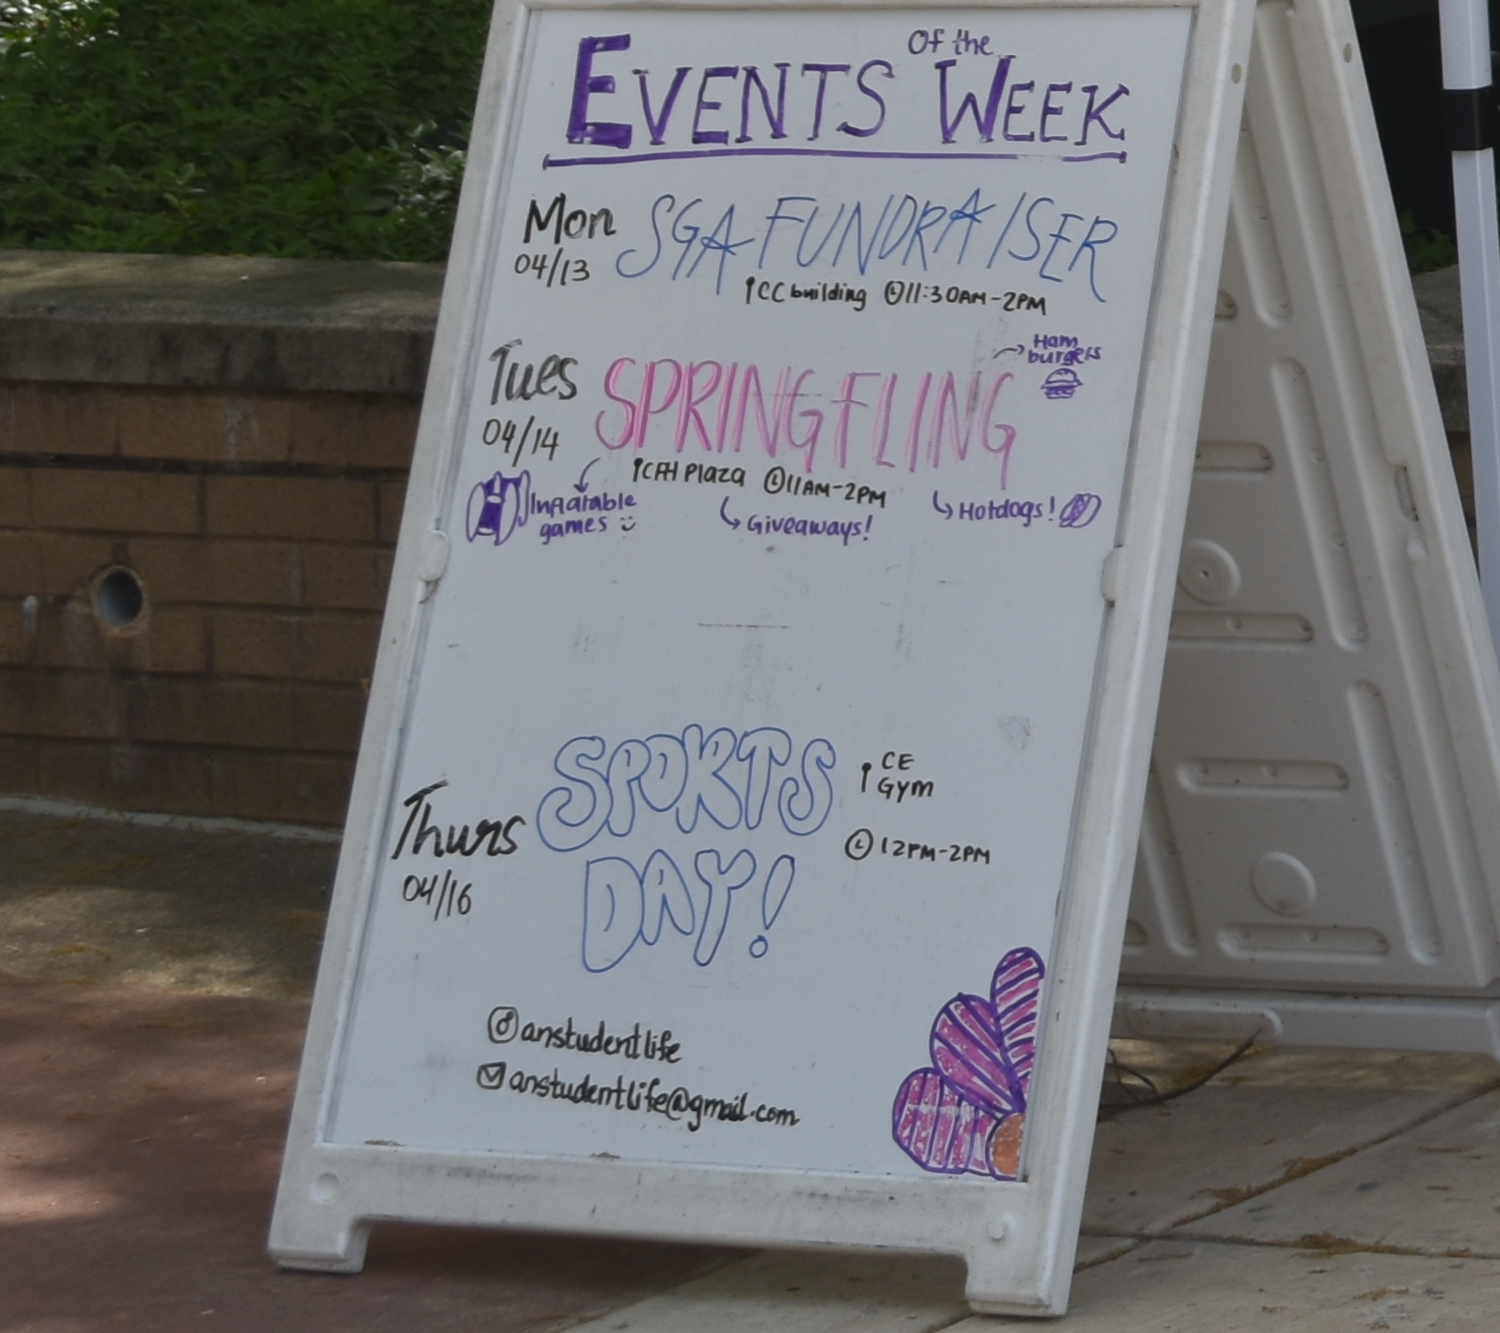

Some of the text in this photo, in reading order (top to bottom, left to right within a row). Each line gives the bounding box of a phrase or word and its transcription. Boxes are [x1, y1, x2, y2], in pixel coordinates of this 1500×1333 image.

[951, 28, 994, 56] the
[567, 34, 896, 149] EVENTS
[934, 54, 1131, 145] WEEK
[522, 187, 1119, 303] Mon SGA FUNDRAISER
[514, 247, 591, 288] 04/13
[757, 281, 785, 304] CC
[790, 282, 868, 312] building
[1027, 346, 1102, 367] burgers
[1033, 334, 1079, 350] Ham
[489, 339, 579, 406] Tues
[482, 416, 560, 468] 04/14
[685, 462, 746, 487] Plaza
[530, 491, 637, 516] Inflatable
[539, 516, 608, 545] games
[747, 514, 874, 546] Giveaways!
[881, 751, 915, 771] CE
[536, 723, 836, 853] SPORTS
[877, 775, 935, 803] Gym
[391, 779, 527, 859] Thurs
[402, 869, 473, 921] 04/16
[581, 849, 796, 974] DAY!
